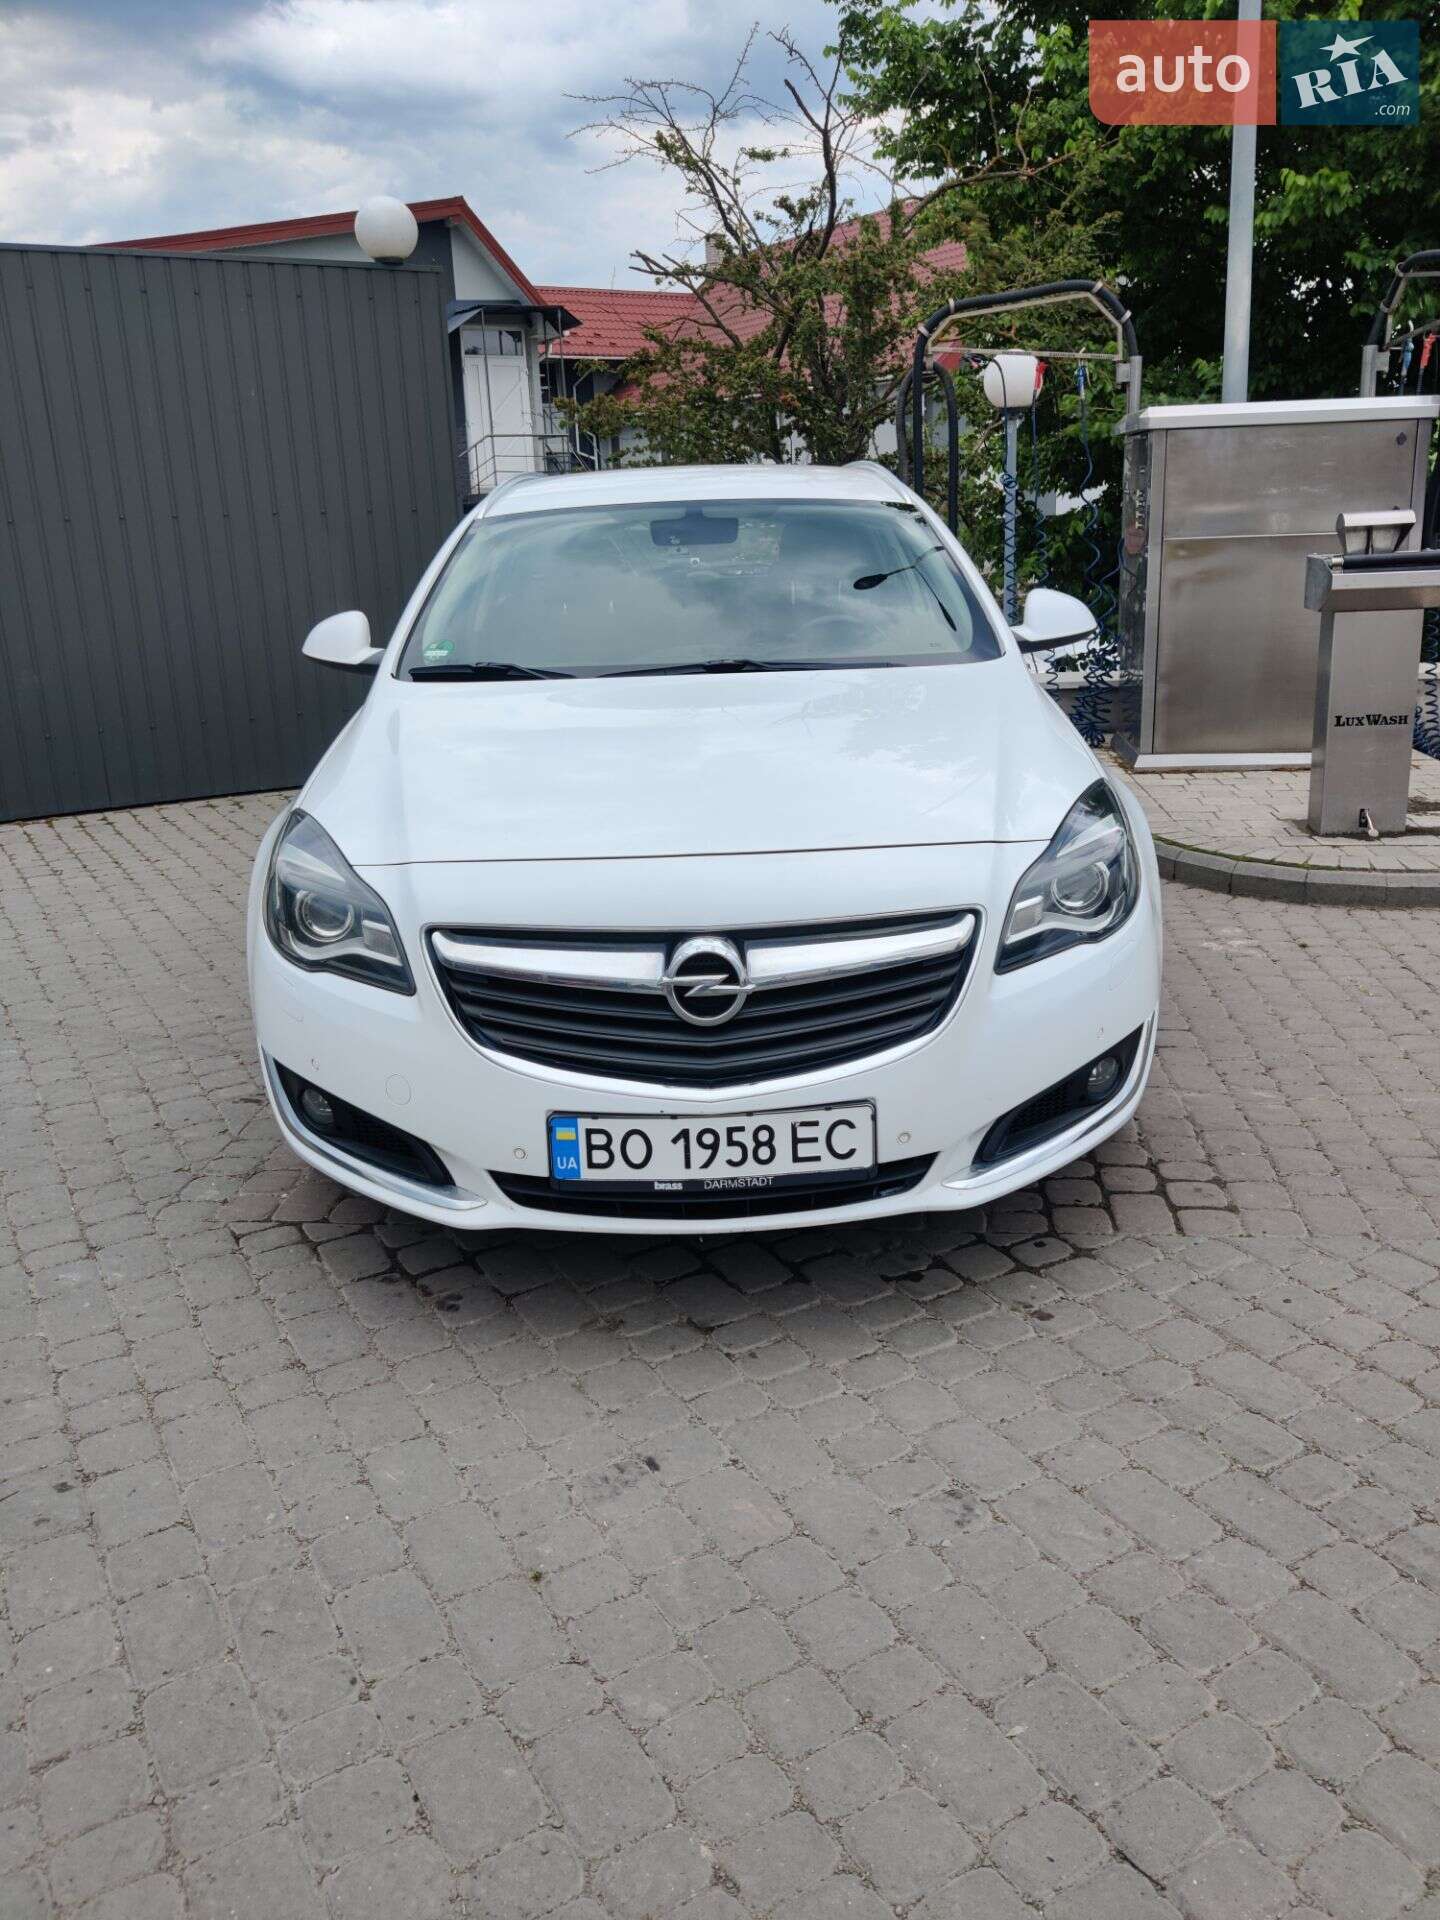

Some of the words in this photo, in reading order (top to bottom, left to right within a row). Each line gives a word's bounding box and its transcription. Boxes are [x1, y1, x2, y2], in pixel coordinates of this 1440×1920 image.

[585, 1128, 653, 1170] BO
[671, 1125, 777, 1170] 1958
[791, 1119, 857, 1164] EC
[556, 1156, 577, 1170] UA
[654, 1181, 684, 1191] brass
[704, 1176, 775, 1190] DARMSTADT
